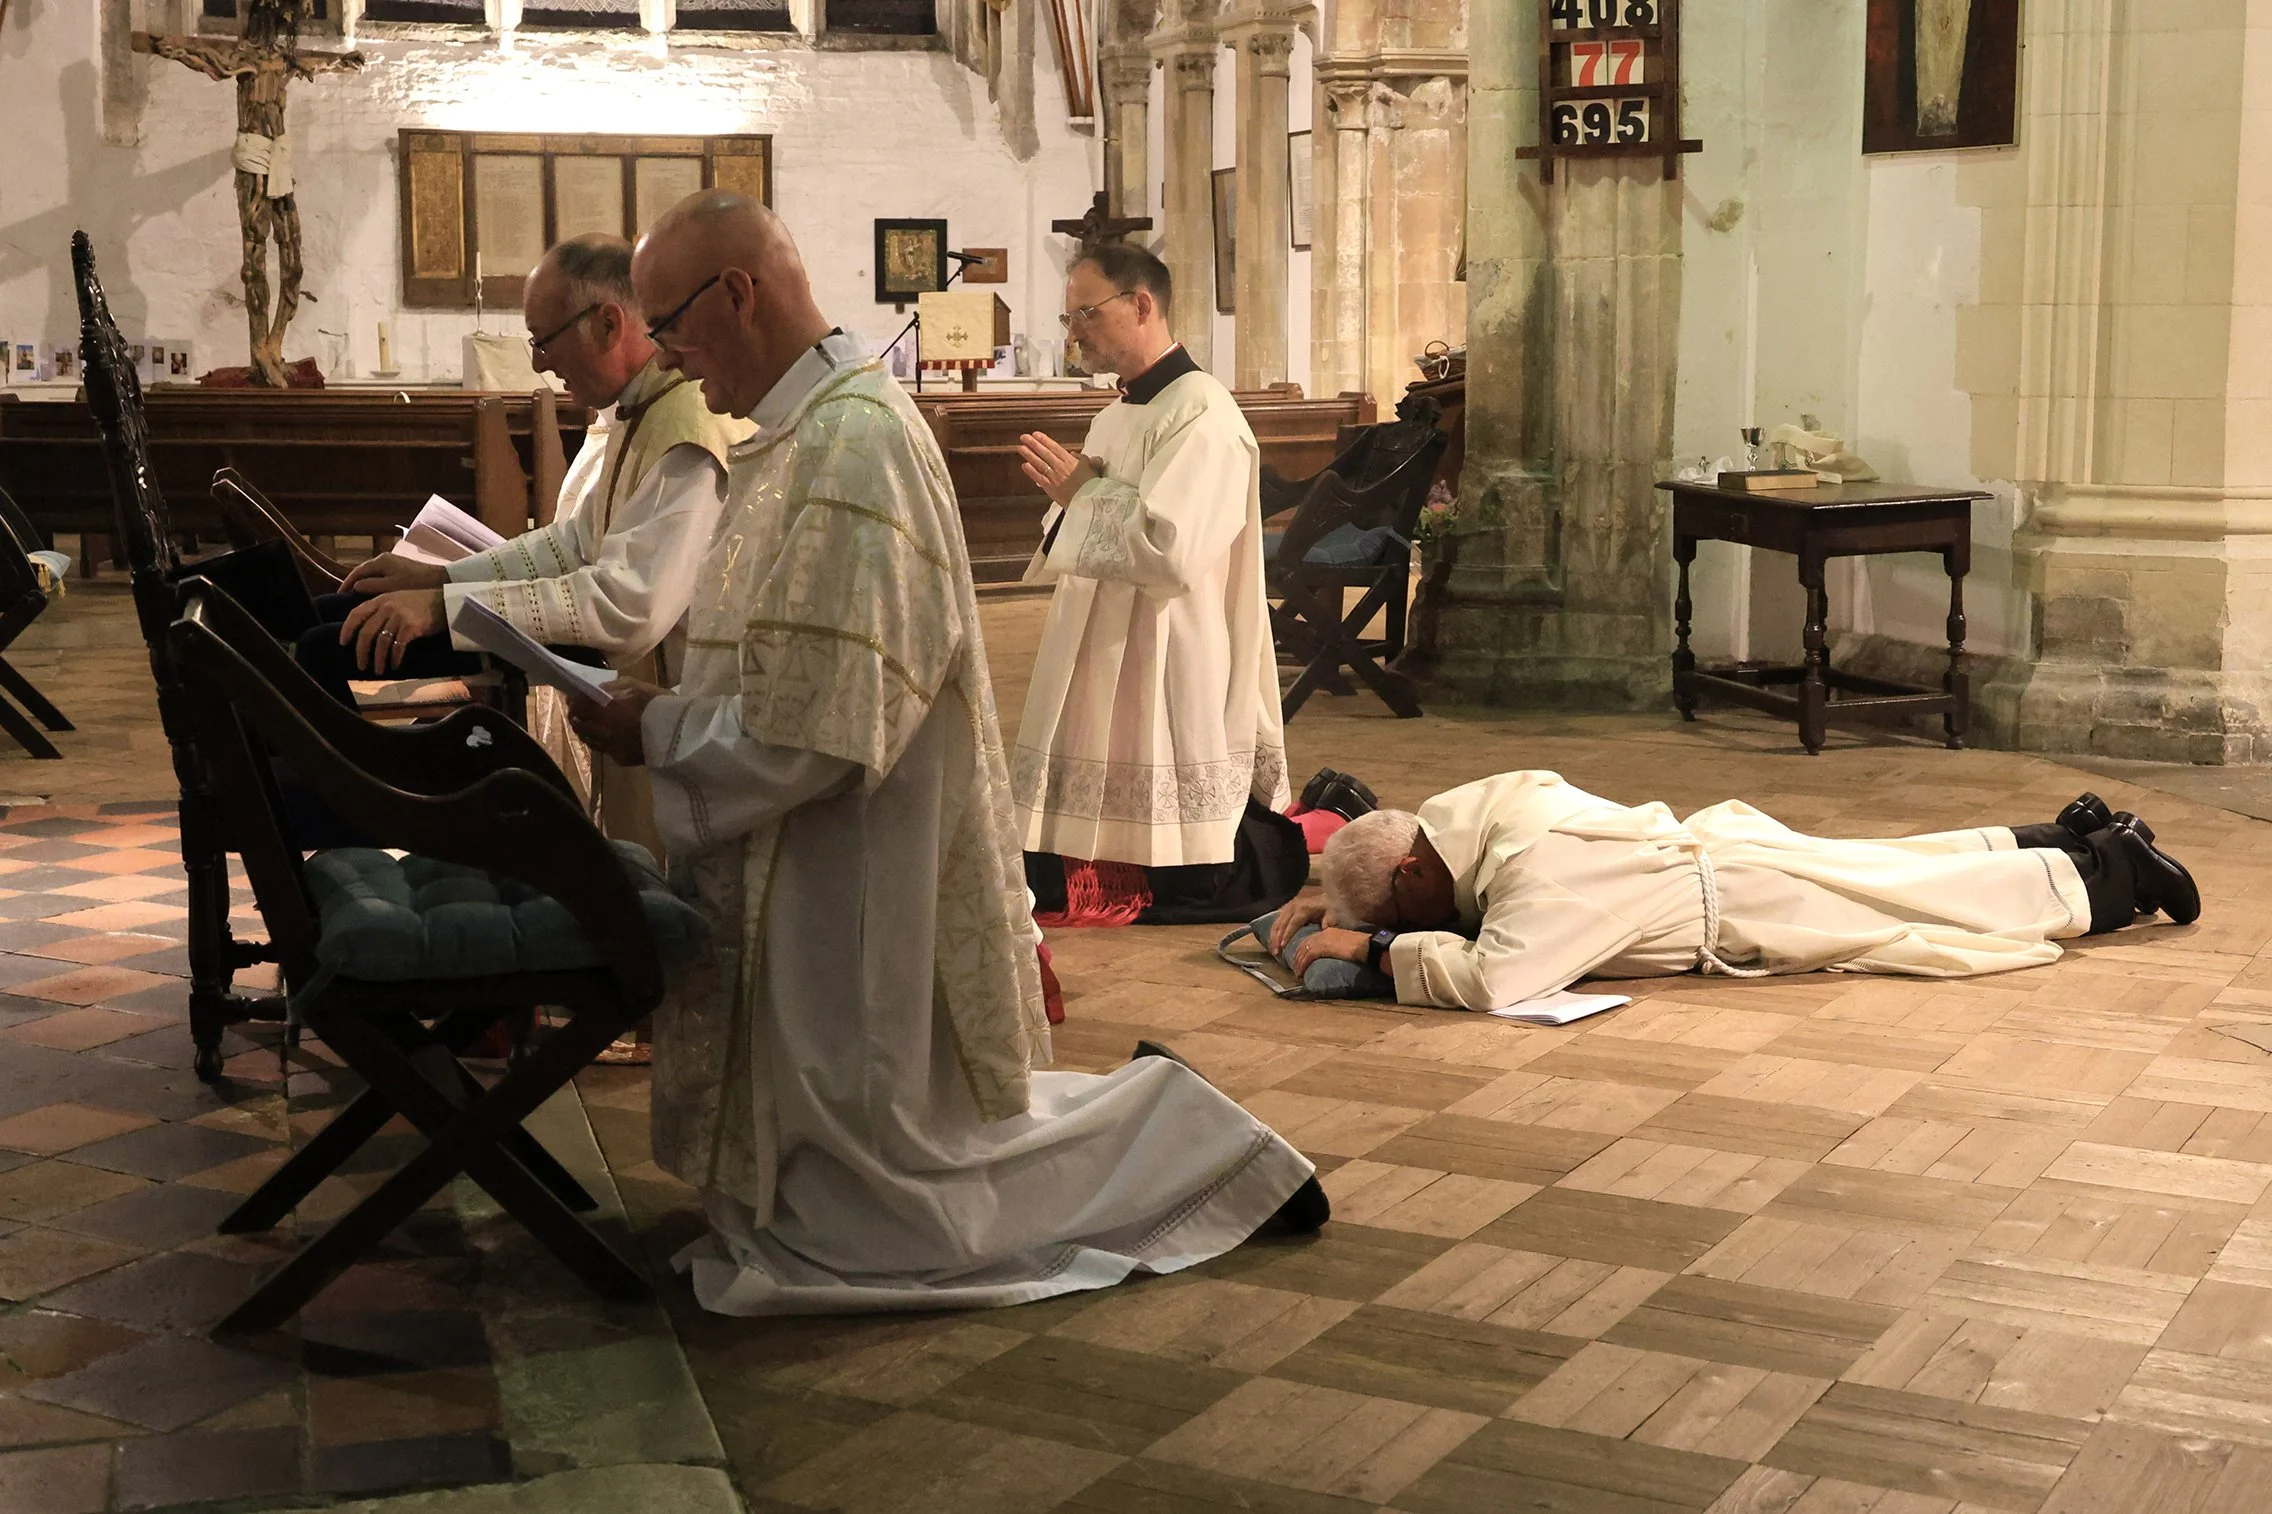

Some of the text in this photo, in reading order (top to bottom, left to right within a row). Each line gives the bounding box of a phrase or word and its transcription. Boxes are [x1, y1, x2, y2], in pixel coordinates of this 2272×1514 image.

[1551, 0, 1653, 28] 408
[1574, 43, 1640, 87] 77
[1553, 101, 1645, 145] 695
